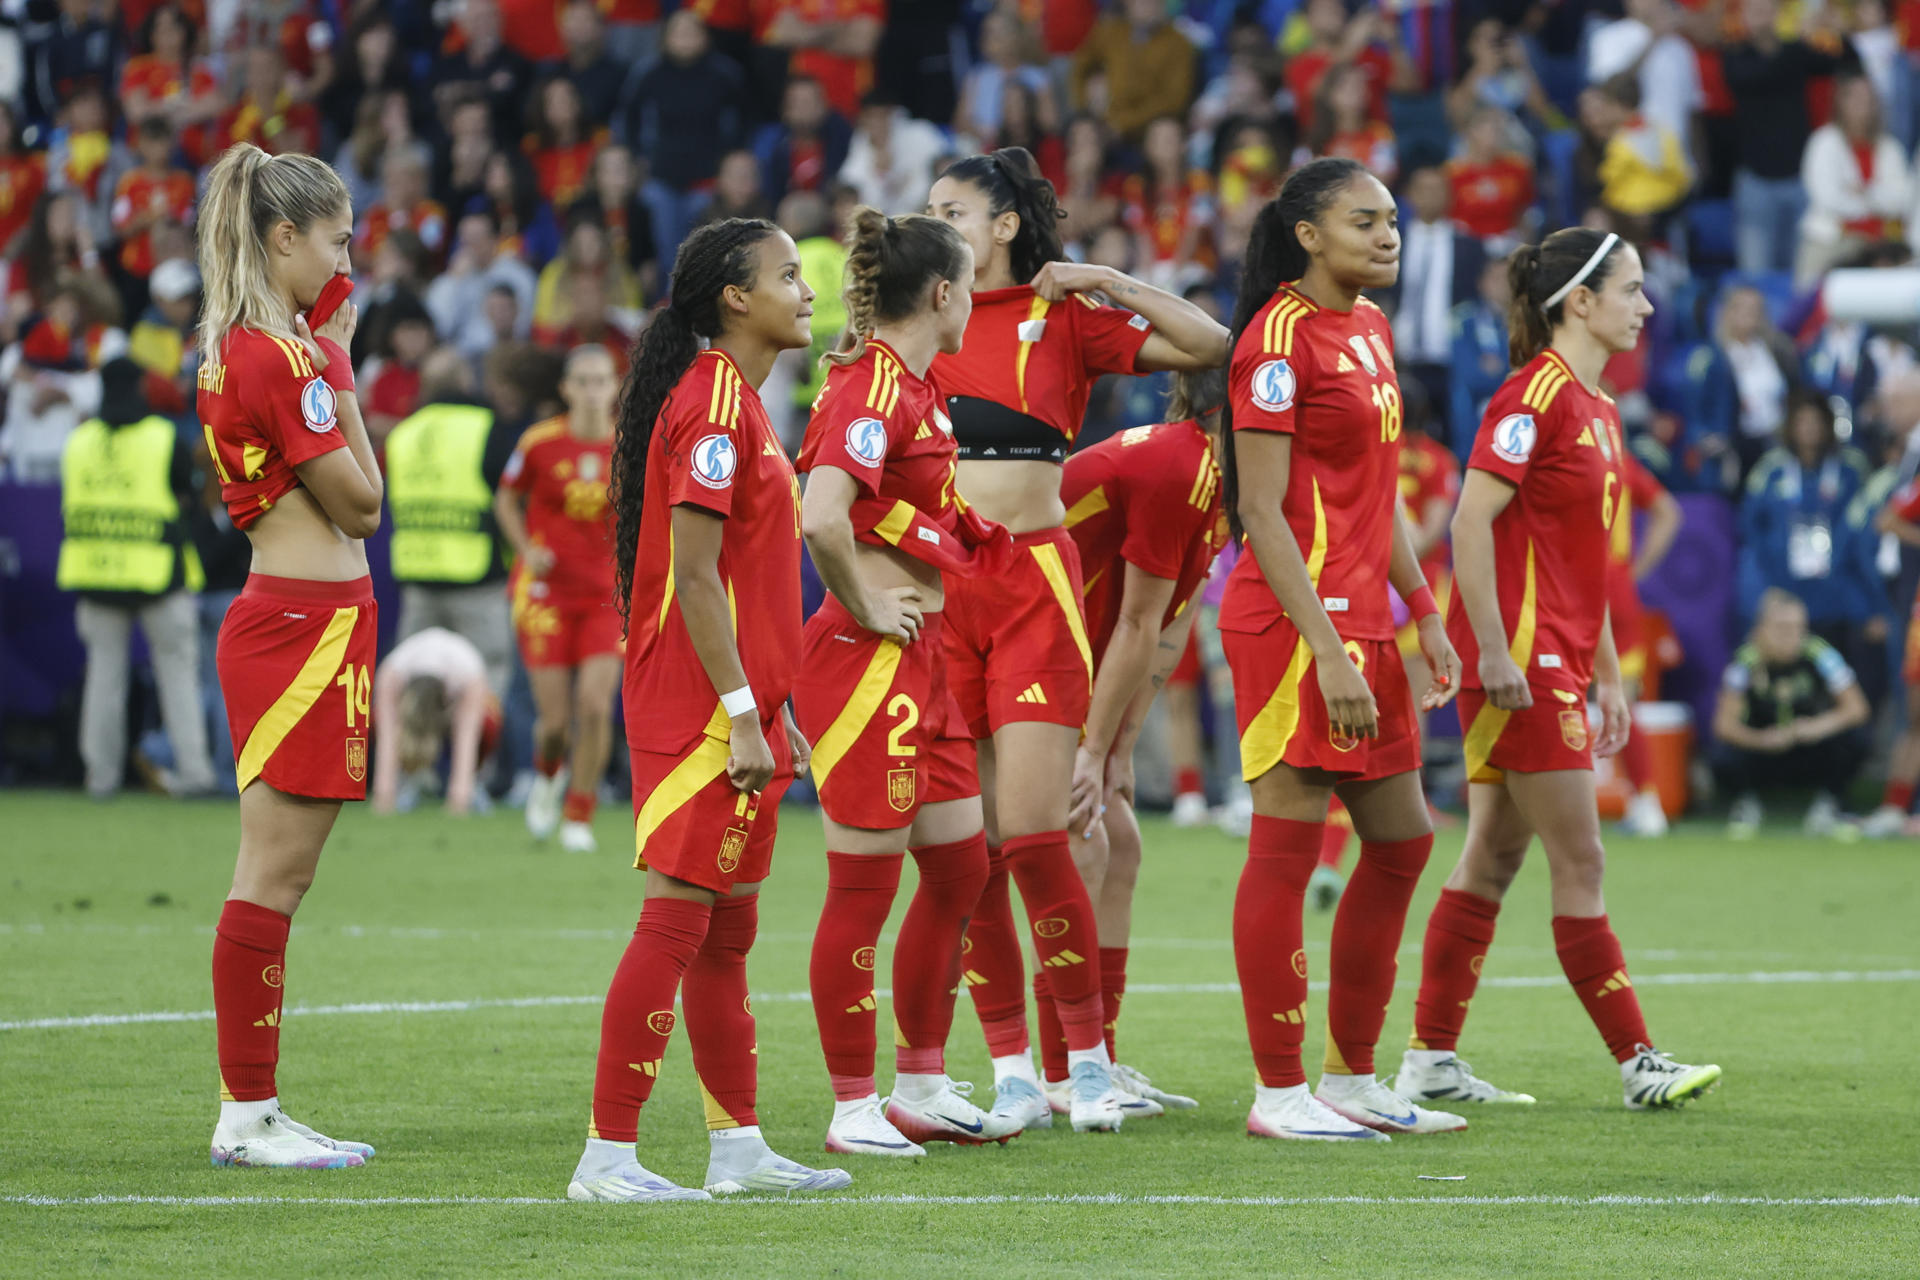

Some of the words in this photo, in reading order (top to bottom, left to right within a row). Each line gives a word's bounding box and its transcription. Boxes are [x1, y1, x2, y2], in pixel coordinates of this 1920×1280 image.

[1371, 382, 1401, 443] 18
[1602, 471, 1616, 531] 6
[886, 692, 919, 757] 2
